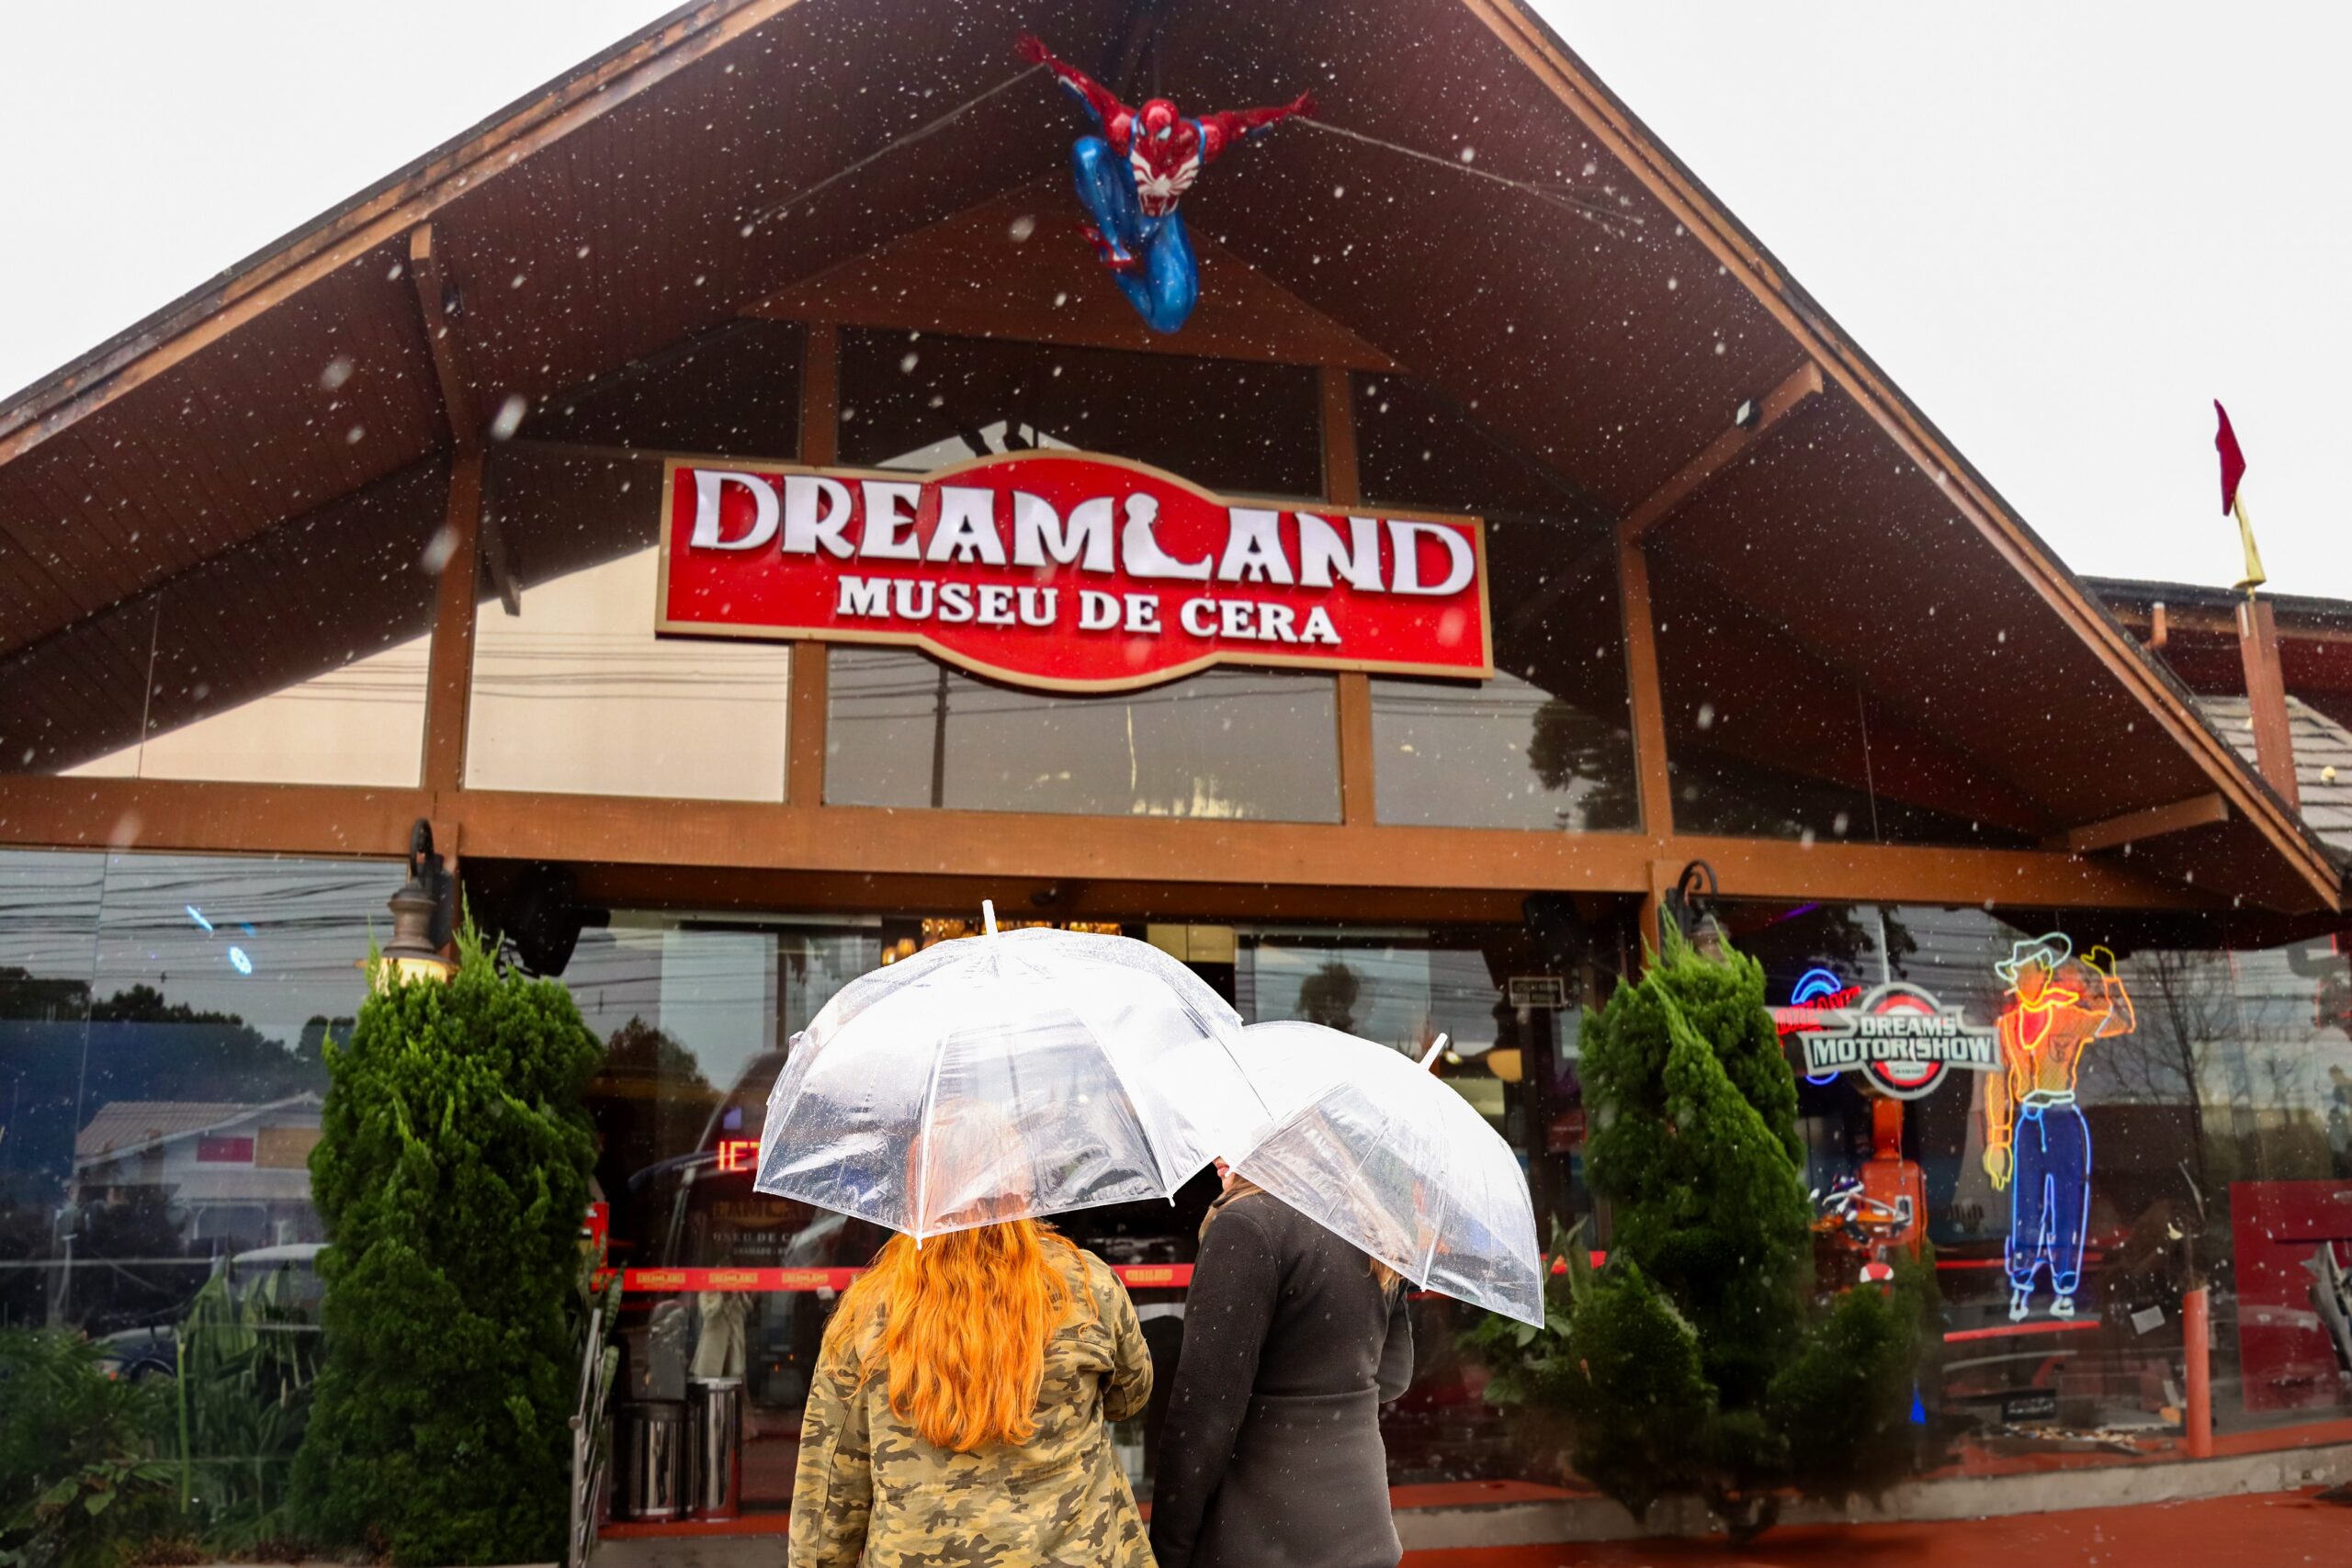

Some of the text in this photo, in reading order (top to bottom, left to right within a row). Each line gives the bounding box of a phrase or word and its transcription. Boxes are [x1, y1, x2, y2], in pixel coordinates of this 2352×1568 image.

[689, 468, 1476, 596] DREAMLAND
[837, 575, 1342, 645] MUSEU DE CERA
[1860, 1016, 1957, 1037] DREAMS
[1812, 1037, 1992, 1066] MOTOR SHOW
